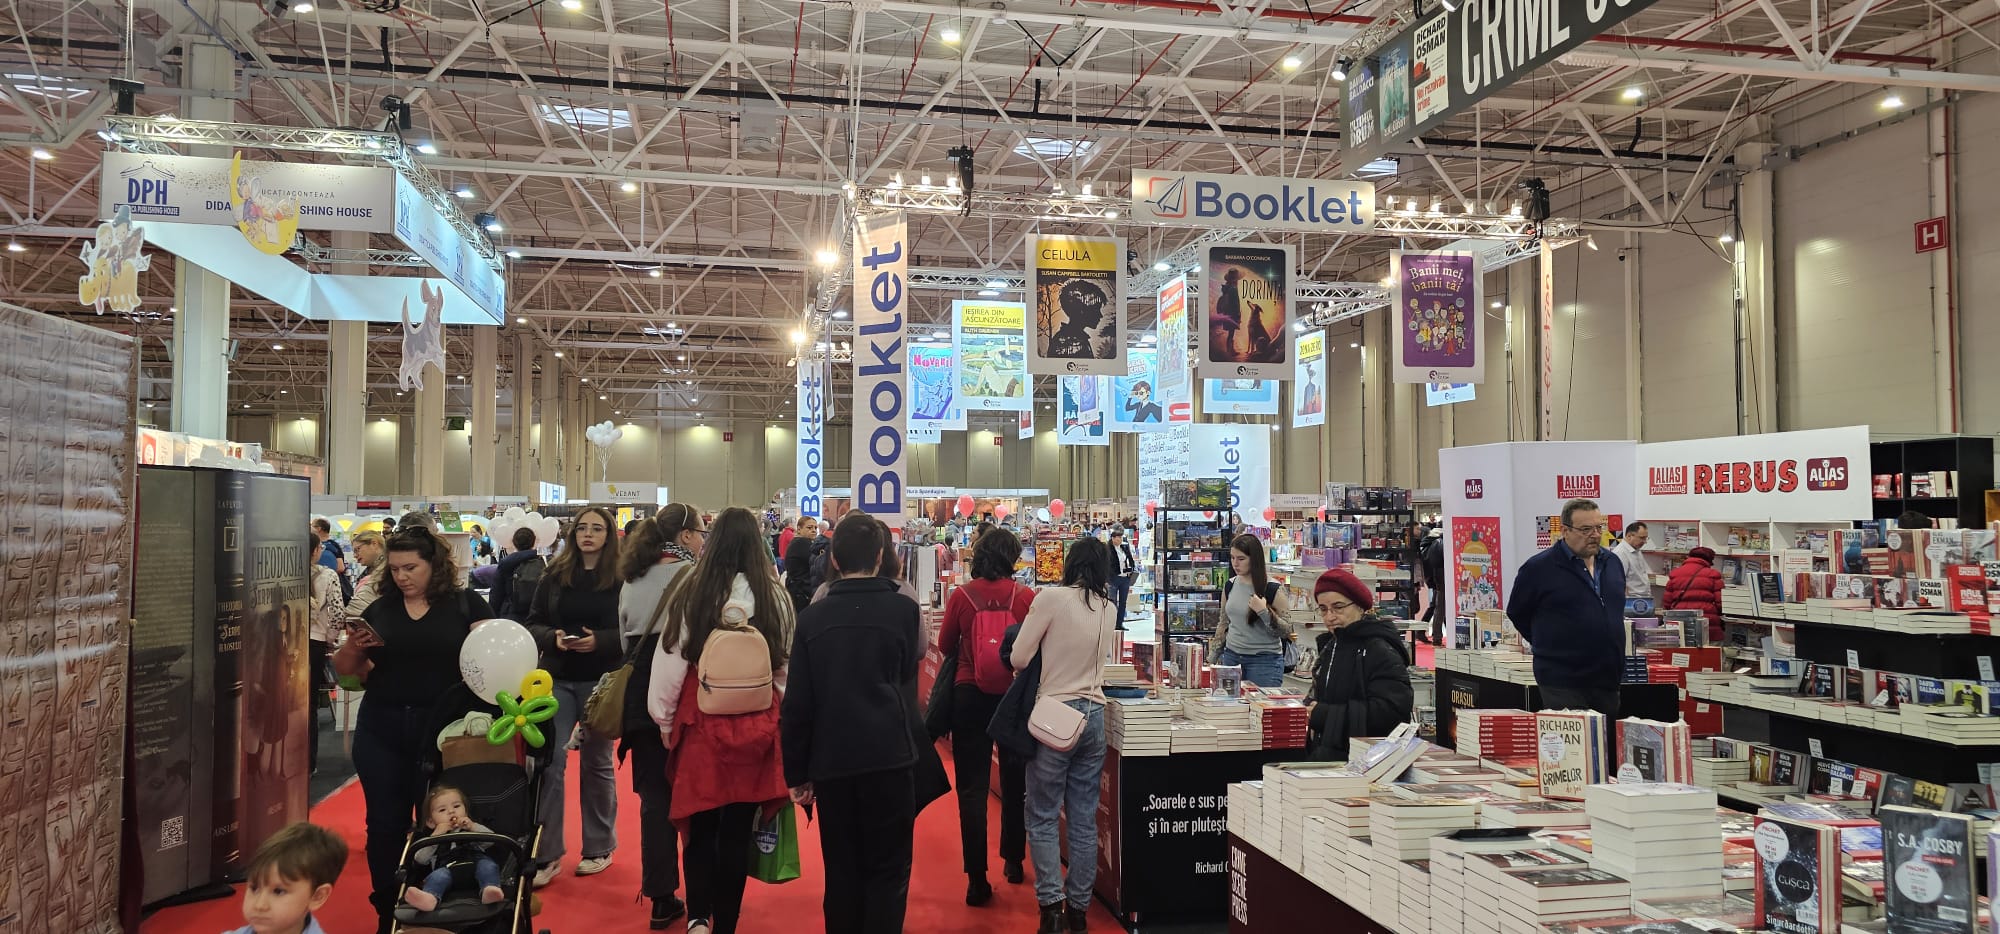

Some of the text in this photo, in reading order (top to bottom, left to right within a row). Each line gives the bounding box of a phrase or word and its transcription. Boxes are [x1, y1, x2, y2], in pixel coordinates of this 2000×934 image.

[1416, 29, 1446, 60] OSMAN
[1461, 0, 1570, 95] CRIME
[1349, 76, 1374, 101] BALDACCI
[1350, 121, 1374, 148] DRUM
[128, 178, 168, 205] DPH
[205, 201, 373, 218] DIDA SHING HOUSE
[1195, 181, 1363, 226] Booklet
[1922, 224, 1939, 246] H
[1041, 248, 1092, 262] CELULA
[1409, 263, 1465, 283] Banii mei,
[1411, 277, 1462, 293] banii tăi
[858, 240, 902, 514] Booklet
[801, 376, 822, 517] Booklet
[1218, 436, 1240, 510] oklet
[1564, 475, 1593, 489] ALIAS
[1655, 466, 1681, 484] ALIAS
[1693, 459, 1799, 495] REBUS
[1809, 466, 1846, 482] ALIAS
[1559, 488, 1599, 499] publishing
[1650, 483, 1686, 494] publishing
[251, 545, 304, 581] THEODOSIA
[1920, 588, 1943, 597] OSMAN
[1542, 767, 1583, 786] CRIMELOR
[1830, 769, 1853, 781] BALDACCI
[1831, 763, 1846, 772] DAVID
[1189, 795, 1196, 808] e
[1198, 795, 1215, 808] sus
[1159, 817, 1170, 834] în
[1172, 820, 1189, 833] aer
[1897, 832, 1963, 856] S.A. COSBY
[1195, 861, 1223, 874] Richard
[1231, 845, 1247, 877] CRIME
[1231, 869, 1247, 901] SCENE
[1231, 893, 1248, 926] PRESS
